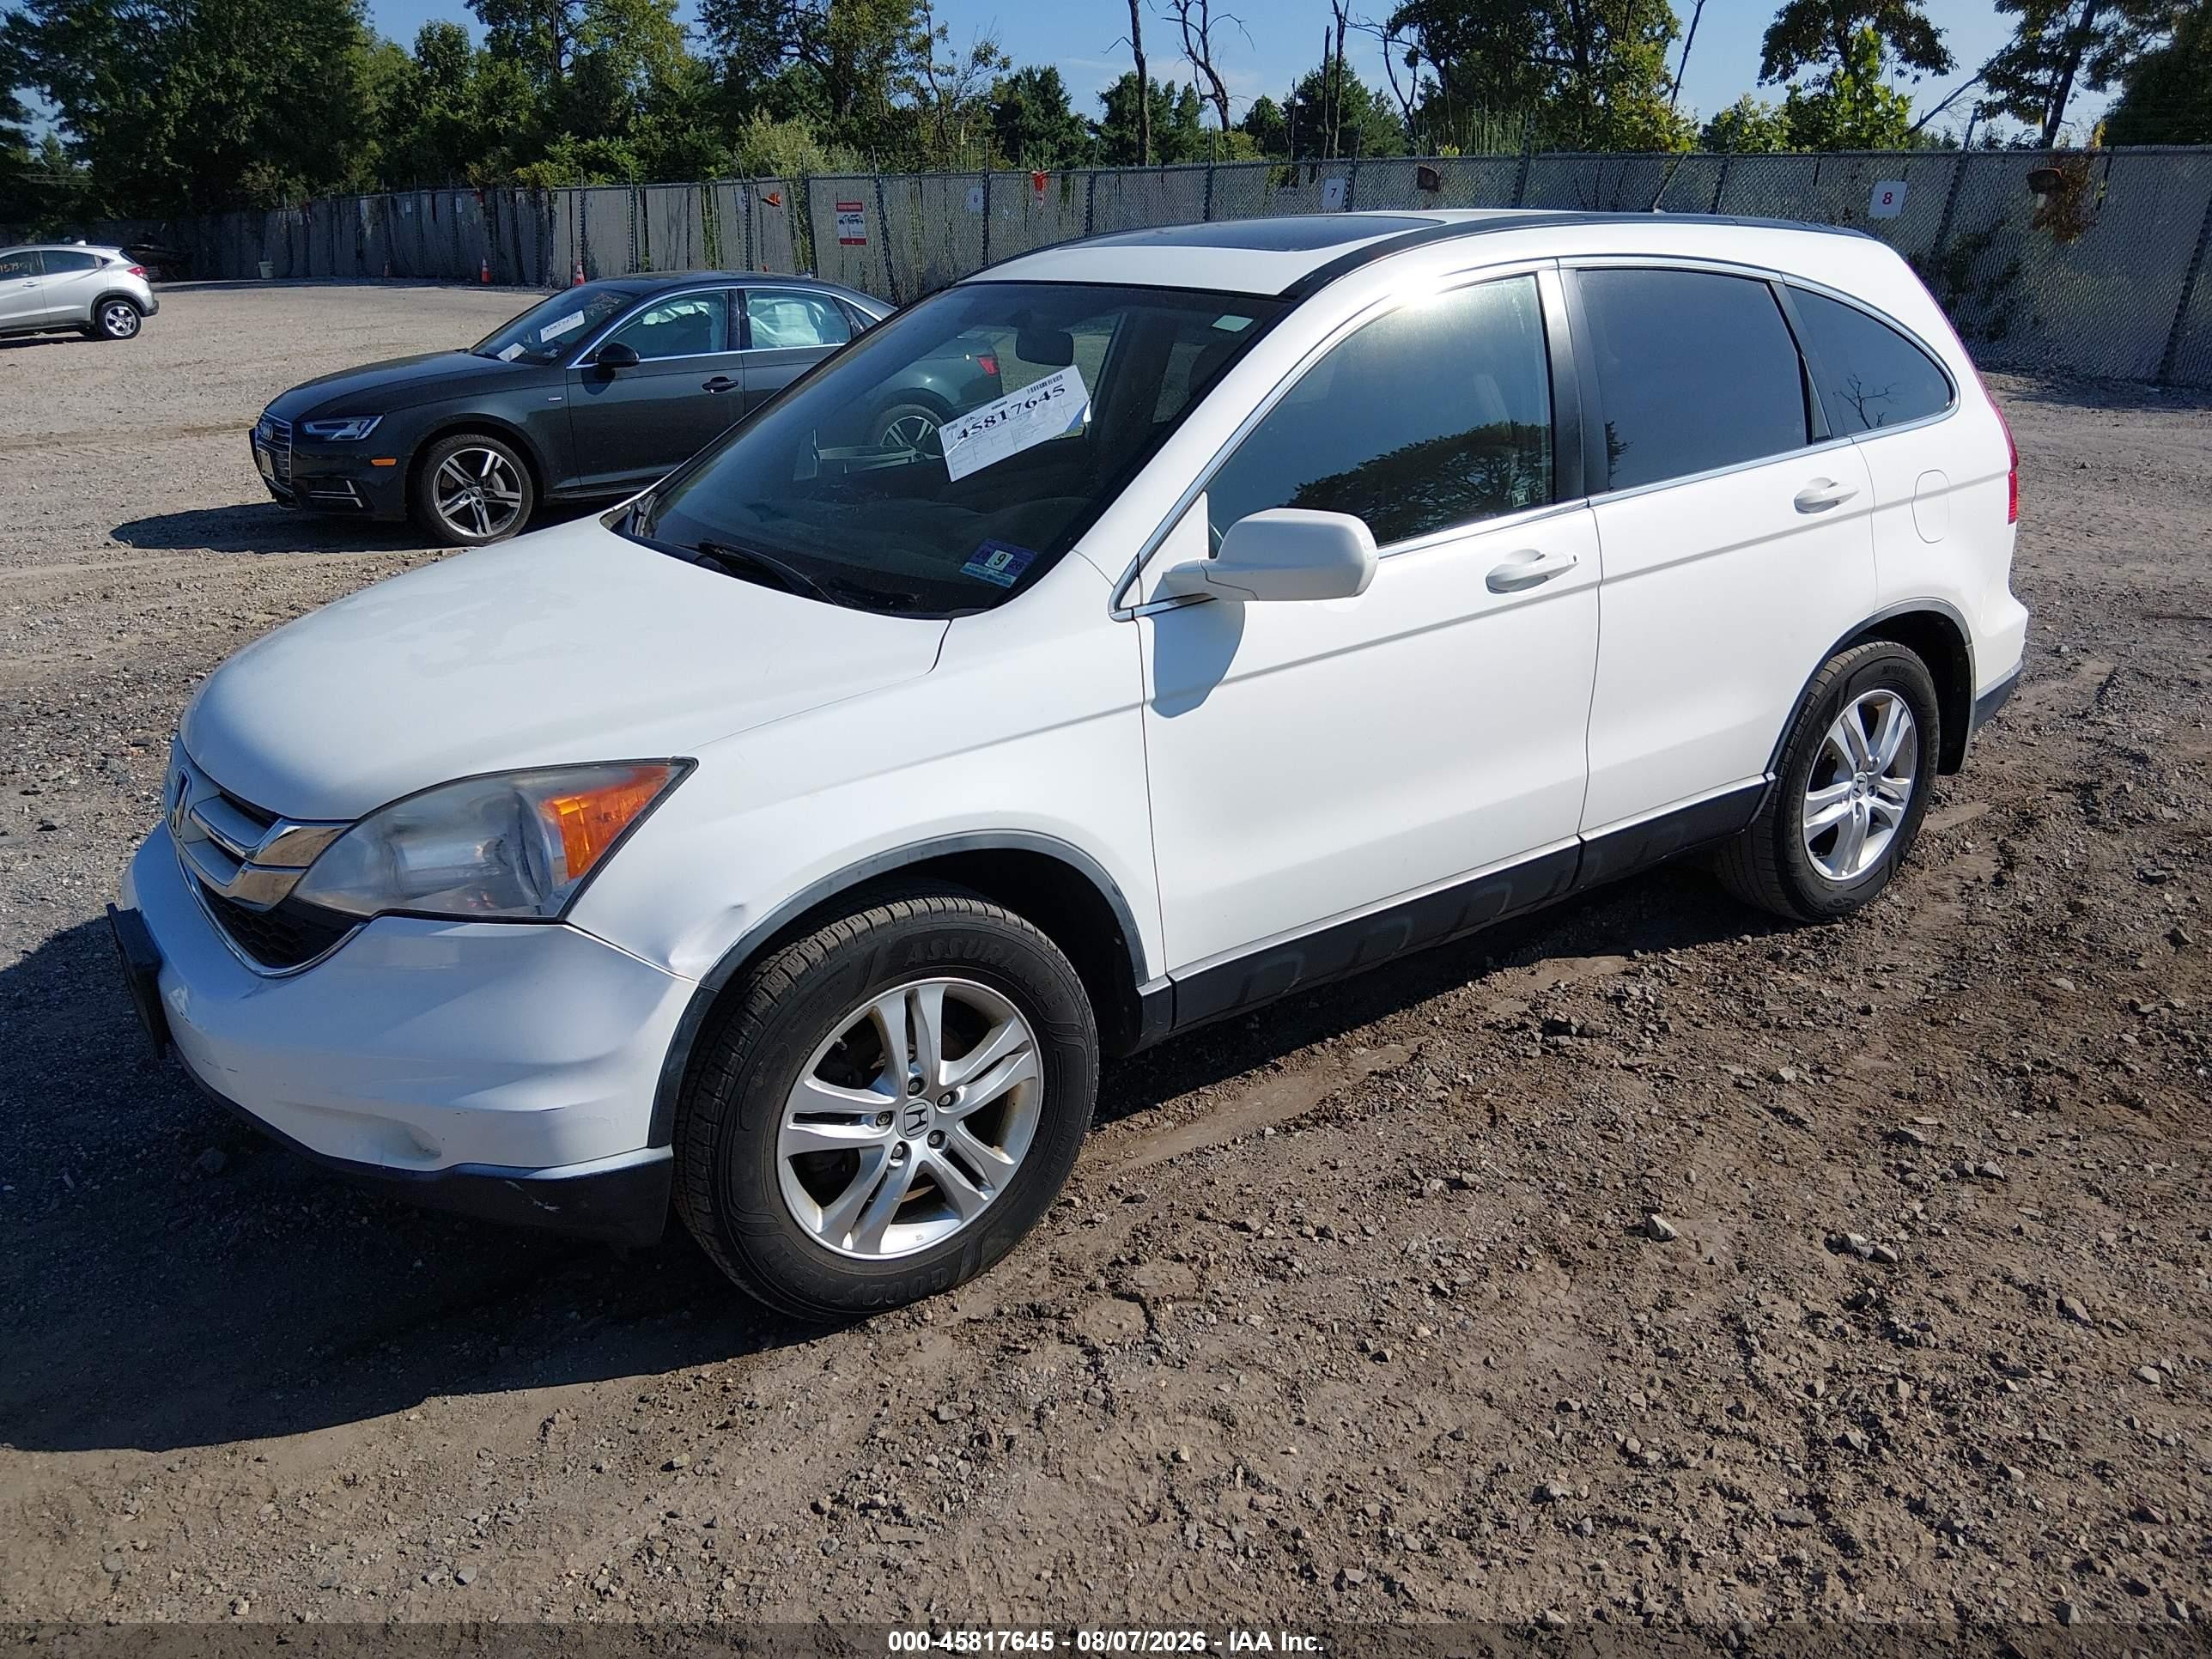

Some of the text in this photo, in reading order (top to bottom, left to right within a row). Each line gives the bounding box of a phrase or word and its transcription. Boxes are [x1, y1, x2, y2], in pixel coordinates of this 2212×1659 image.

[973, 194, 979, 204] 6
[1331, 187, 1338, 198] 7
[1881, 191, 1893, 205] 8
[957, 384, 1066, 440] 45817645
[994, 553, 1007, 567] 9
[903, 936, 1065, 1011] ASSURACE
